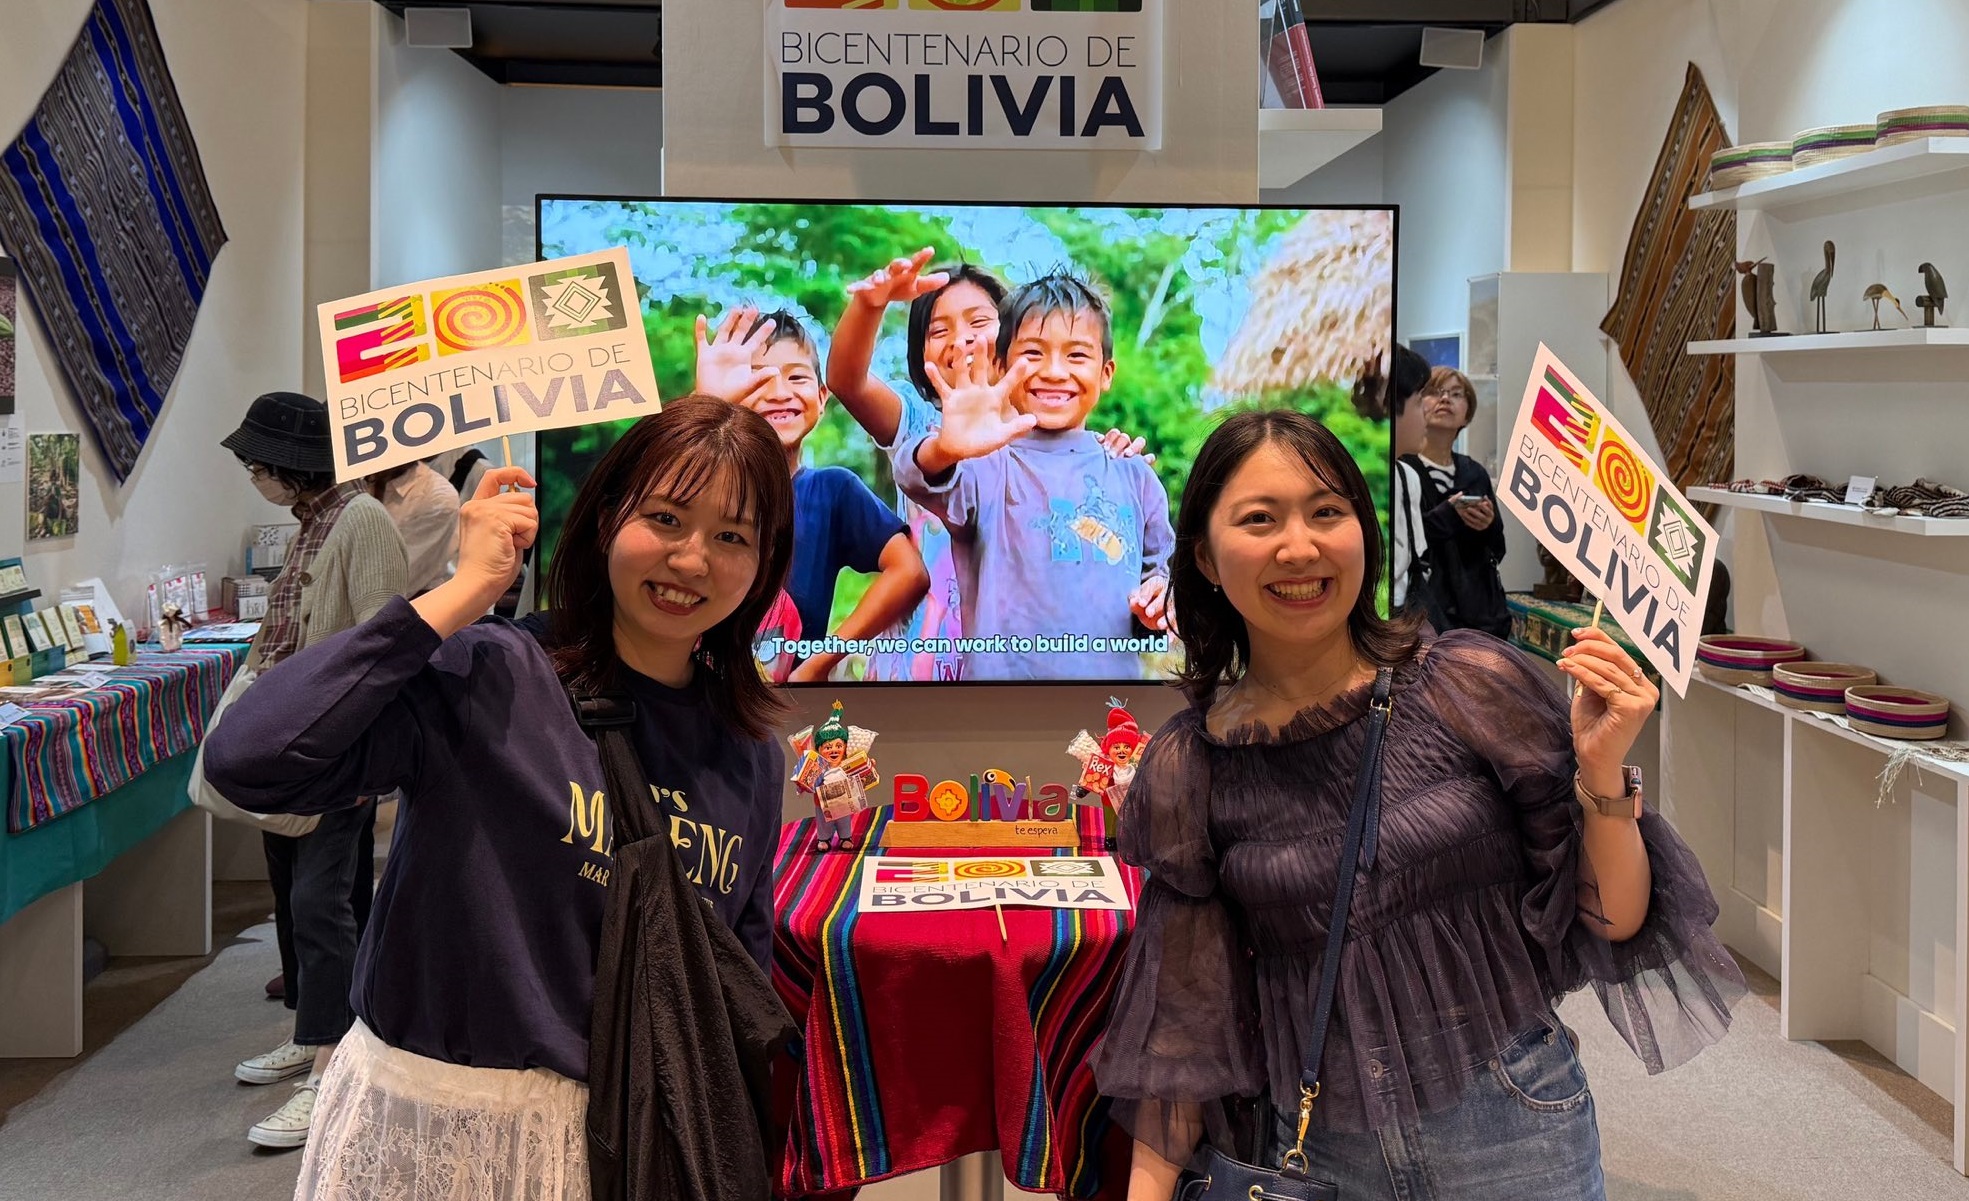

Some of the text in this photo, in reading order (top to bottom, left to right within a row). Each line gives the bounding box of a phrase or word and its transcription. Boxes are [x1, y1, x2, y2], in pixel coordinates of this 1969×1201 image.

[782, 32, 1136, 67] BICENTENARIO DE
[782, 72, 1145, 137] BOLIVIA
[340, 343, 631, 419] BICENTENARIO DE
[342, 368, 647, 466] BOLIVIA
[1519, 434, 1690, 627] BICENTENARIO DE
[1509, 456, 1681, 673] BOLIVIA
[771, 633, 1168, 659] Together, we can work to build a world
[1089, 759, 1112, 776] Rex
[893, 773, 1069, 822] Bolivia
[1015, 825, 1059, 838] te espera
[872, 880, 1106, 894] BICENTENARIO DE
[872, 887, 1116, 906] BOLIVIA
